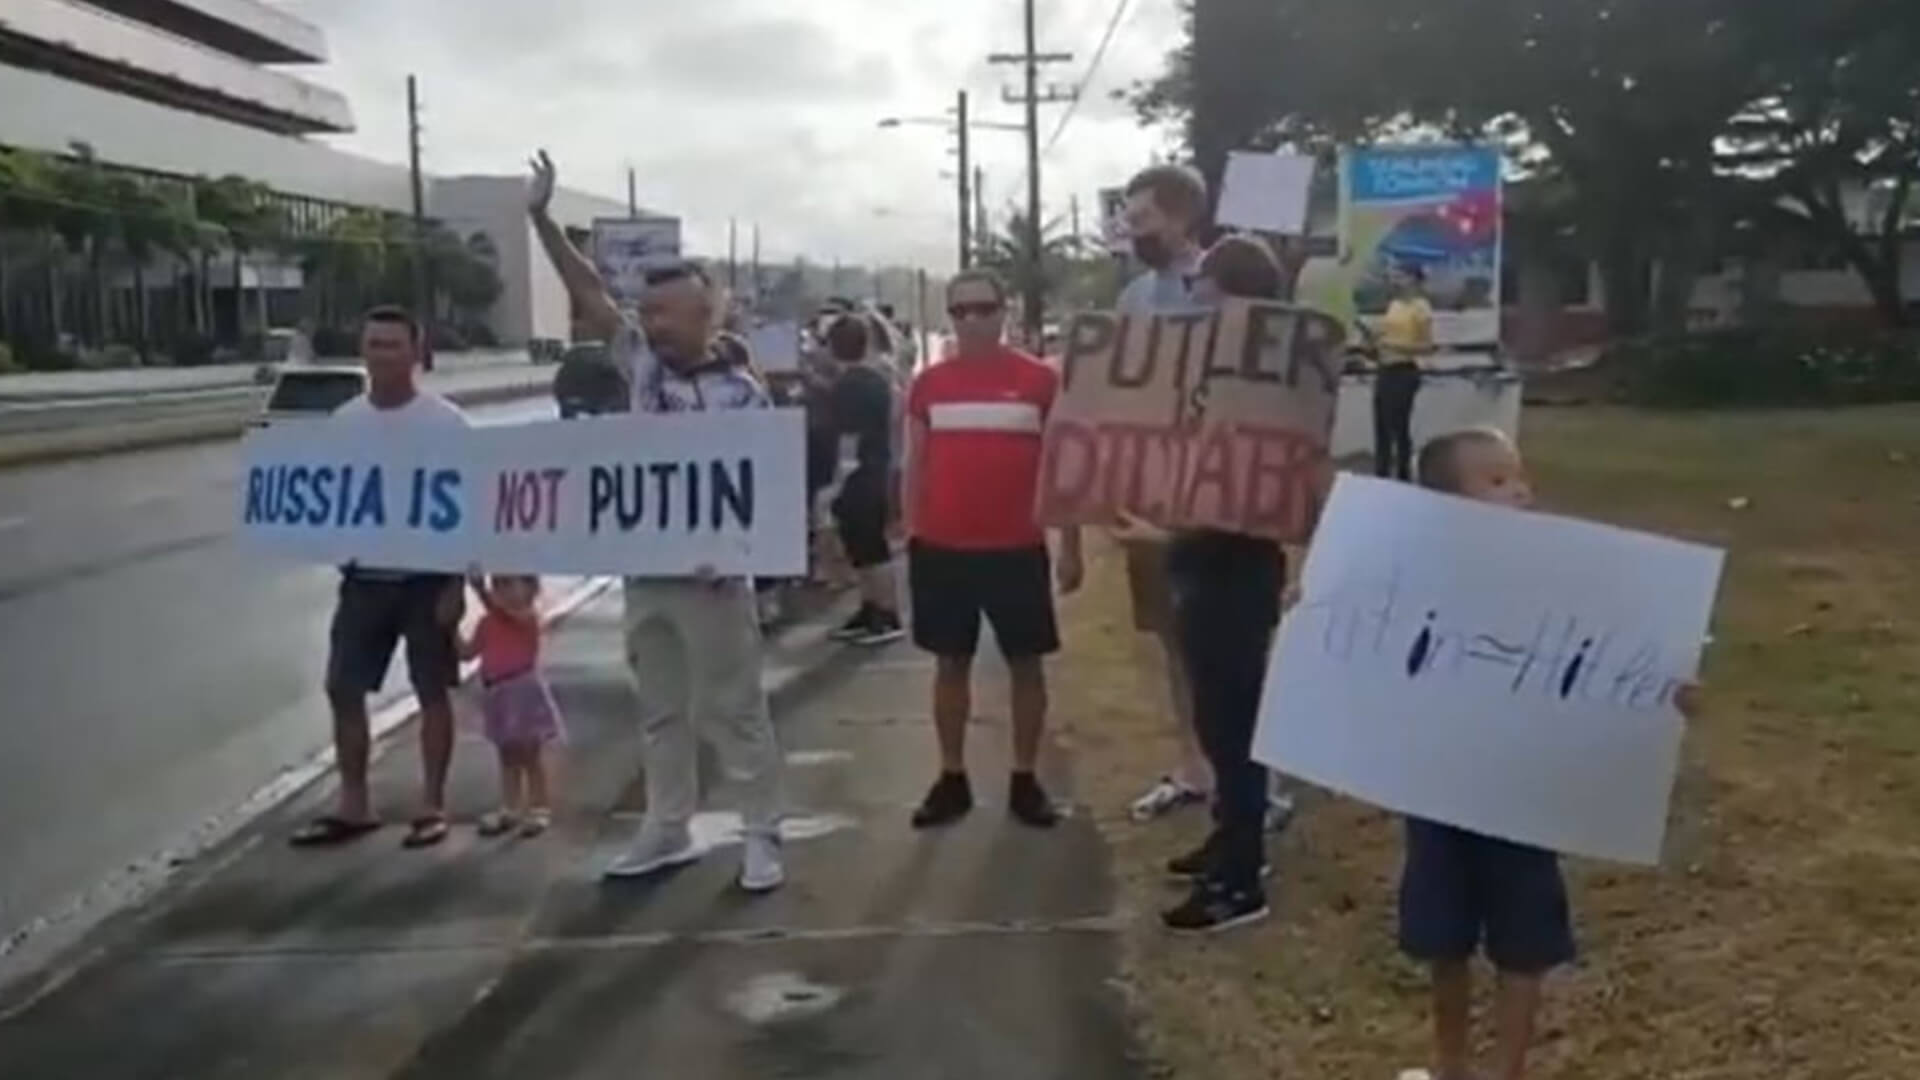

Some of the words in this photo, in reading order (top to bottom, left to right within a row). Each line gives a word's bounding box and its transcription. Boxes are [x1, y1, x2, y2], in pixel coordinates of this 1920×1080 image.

[1062, 303, 1346, 394] PUTLER
[244, 464, 385, 528] RUSSIA
[408, 467, 462, 530] IS
[494, 467, 568, 533] NOT
[589, 457, 755, 533] PUTIN
